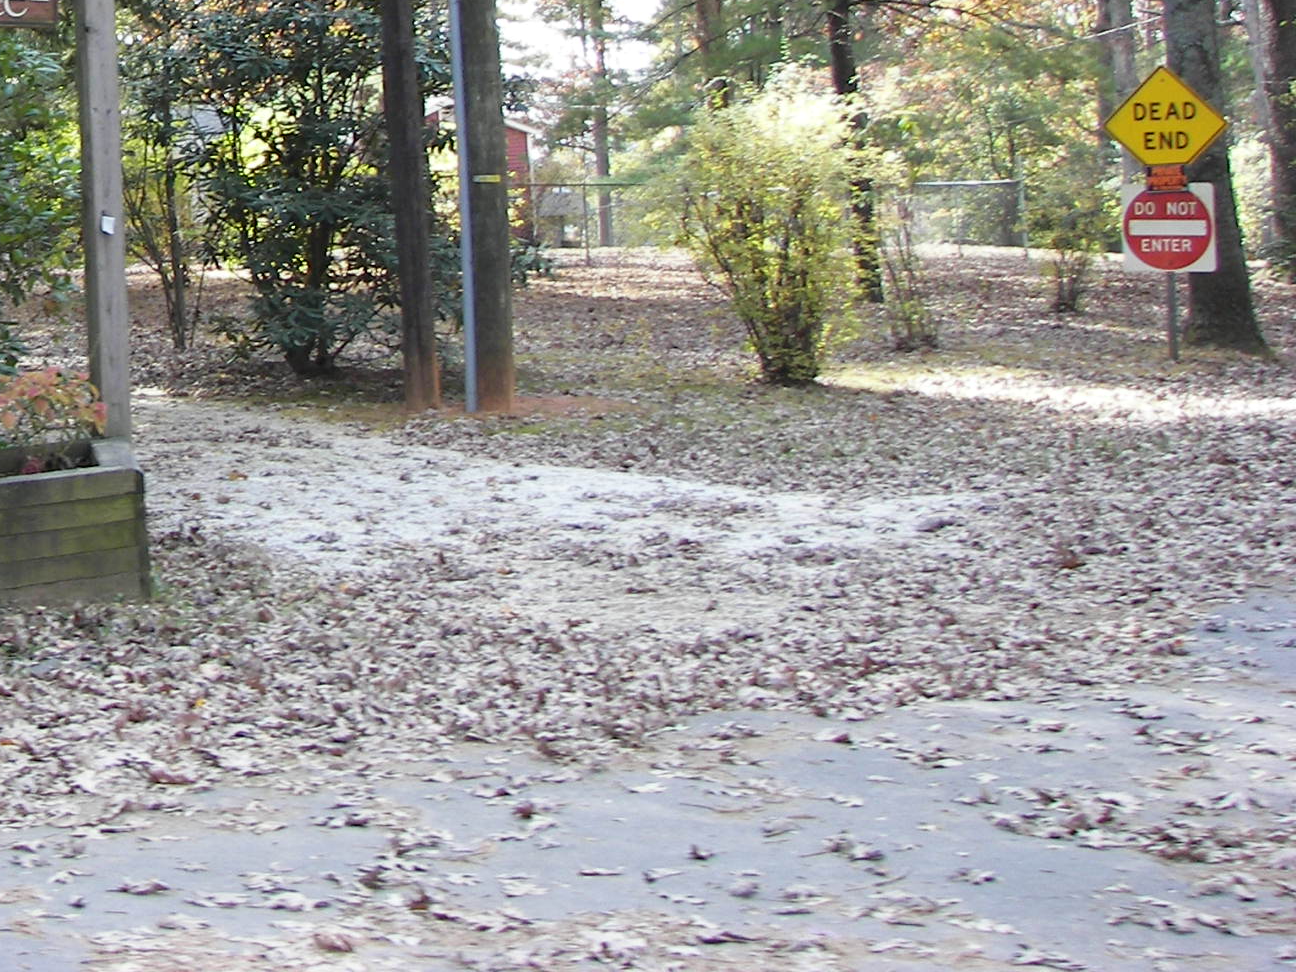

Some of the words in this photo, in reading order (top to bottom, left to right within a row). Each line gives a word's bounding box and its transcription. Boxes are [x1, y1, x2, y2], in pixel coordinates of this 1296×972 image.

[1133, 102, 1196, 121] DEAD
[1144, 131, 1189, 150] END
[1134, 201, 1155, 215] DO
[1166, 201, 1197, 215] NOT
[1140, 238, 1193, 253] ENTER
